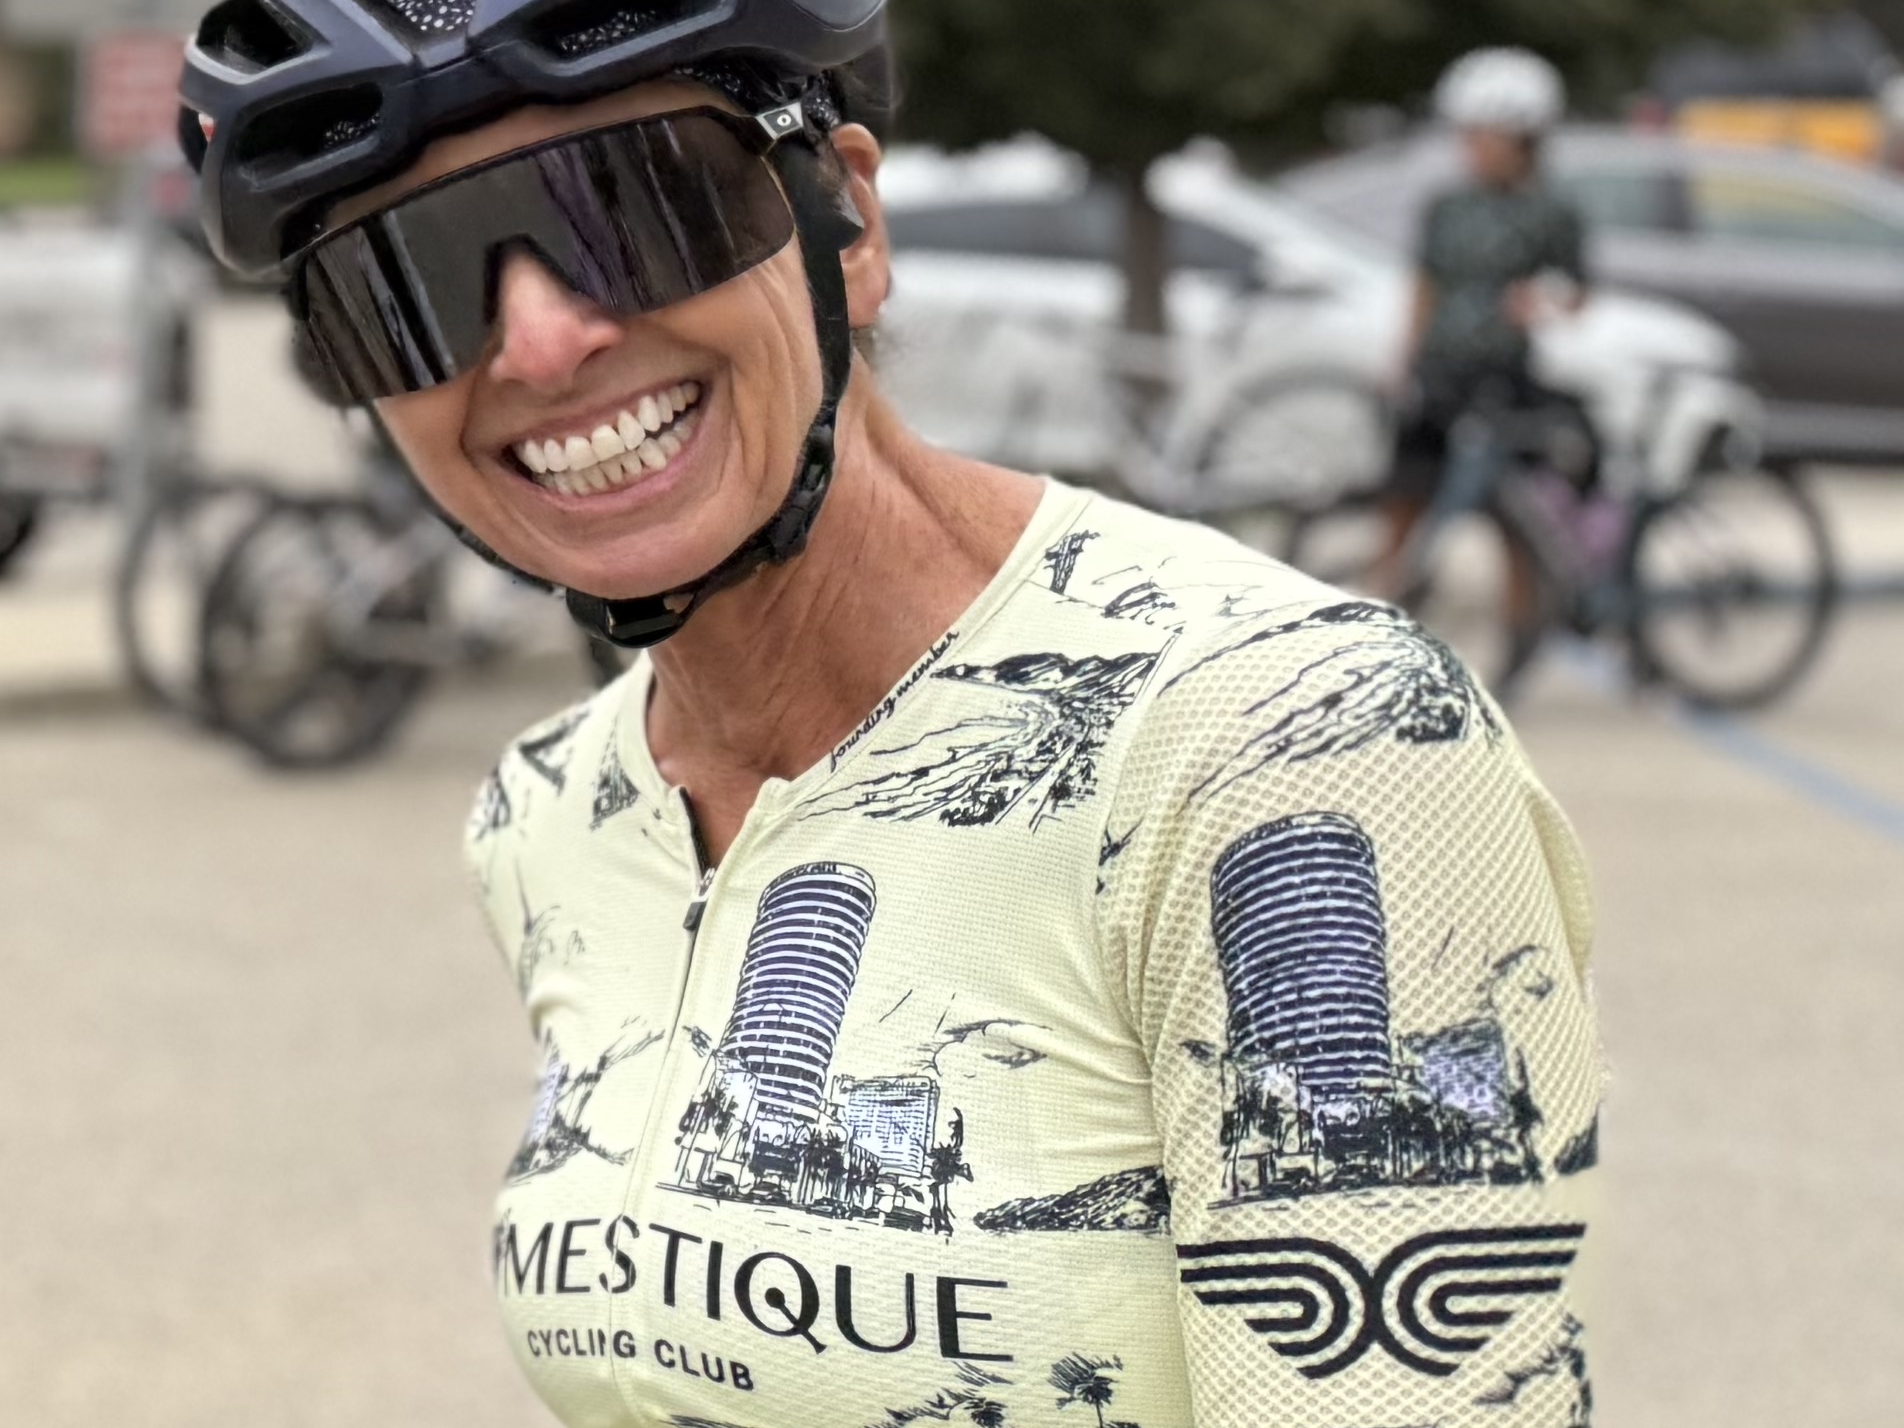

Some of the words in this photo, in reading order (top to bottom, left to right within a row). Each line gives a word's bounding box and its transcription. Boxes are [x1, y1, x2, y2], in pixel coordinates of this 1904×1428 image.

[829, 696, 897, 773] founding
[895, 630, 960, 698] member
[495, 1214, 1014, 1362] MESTIQUE
[527, 1328, 637, 1360] CYCLING
[652, 1337, 756, 1392] CLUB
